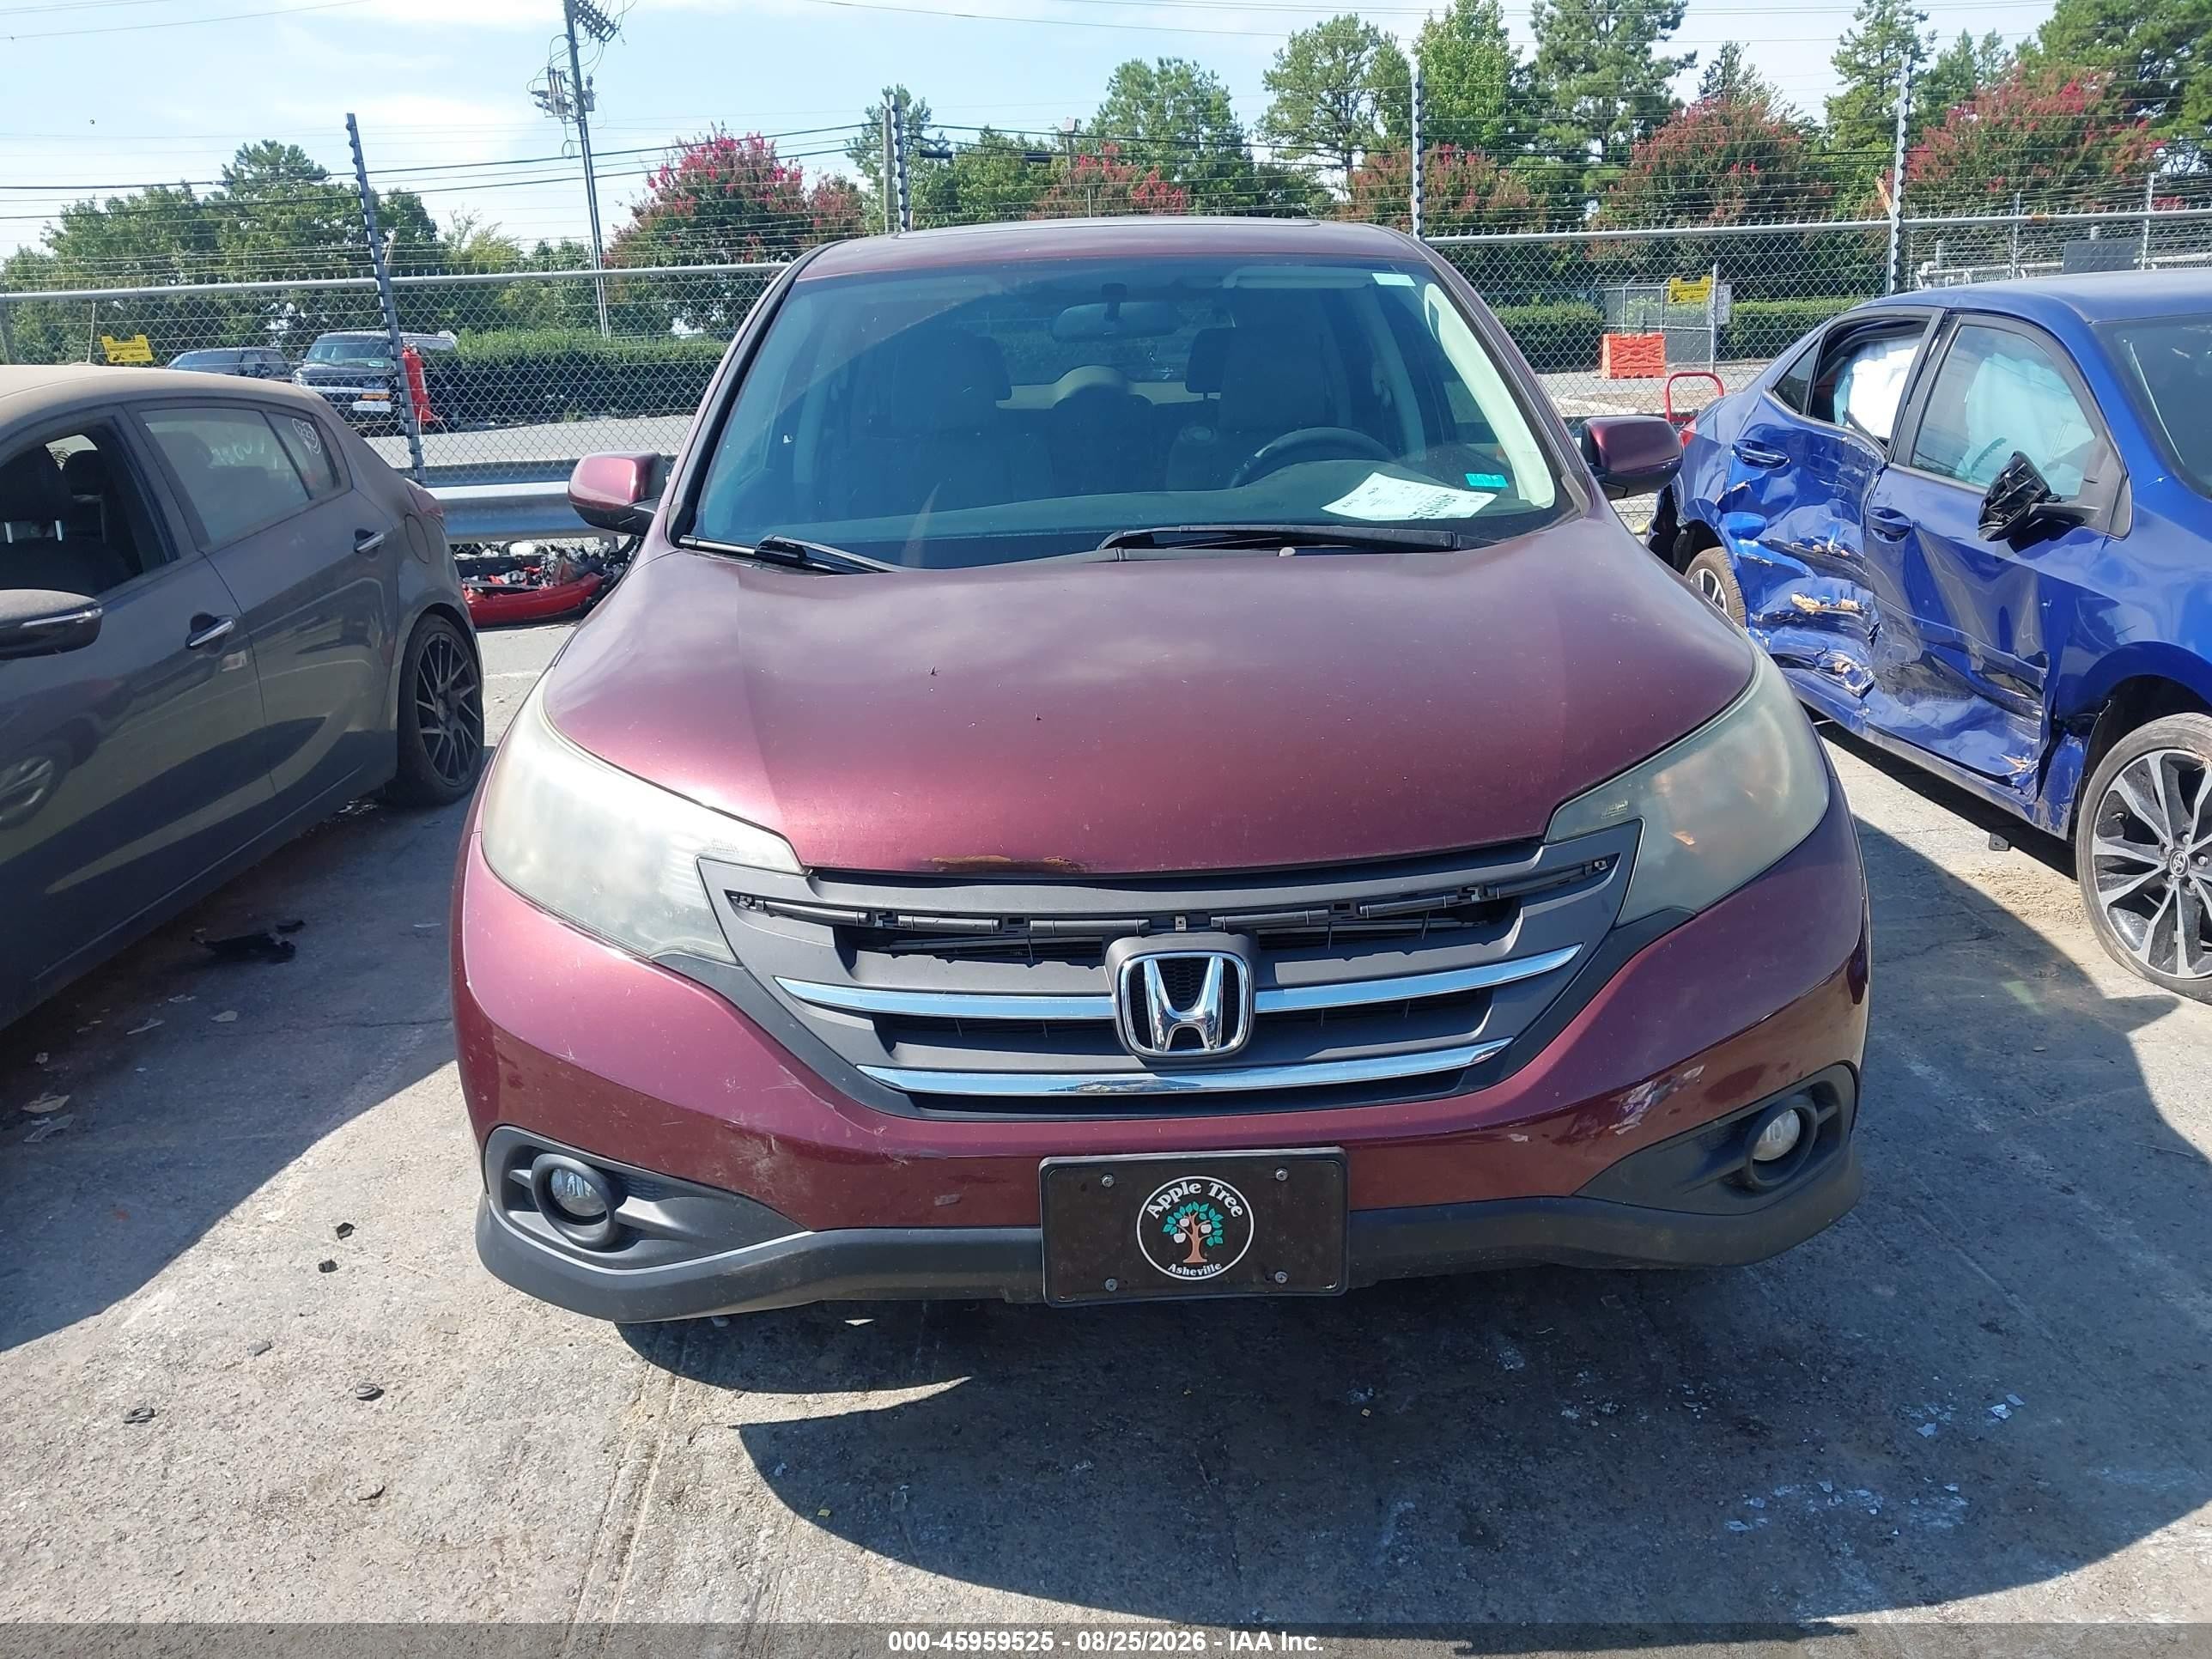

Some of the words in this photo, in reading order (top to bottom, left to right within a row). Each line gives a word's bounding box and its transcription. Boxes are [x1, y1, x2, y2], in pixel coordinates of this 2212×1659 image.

[1146, 1182, 1202, 1219] Apple
[1207, 1182, 1243, 1218] Tree
[1168, 1263, 1222, 1276] Asheville
